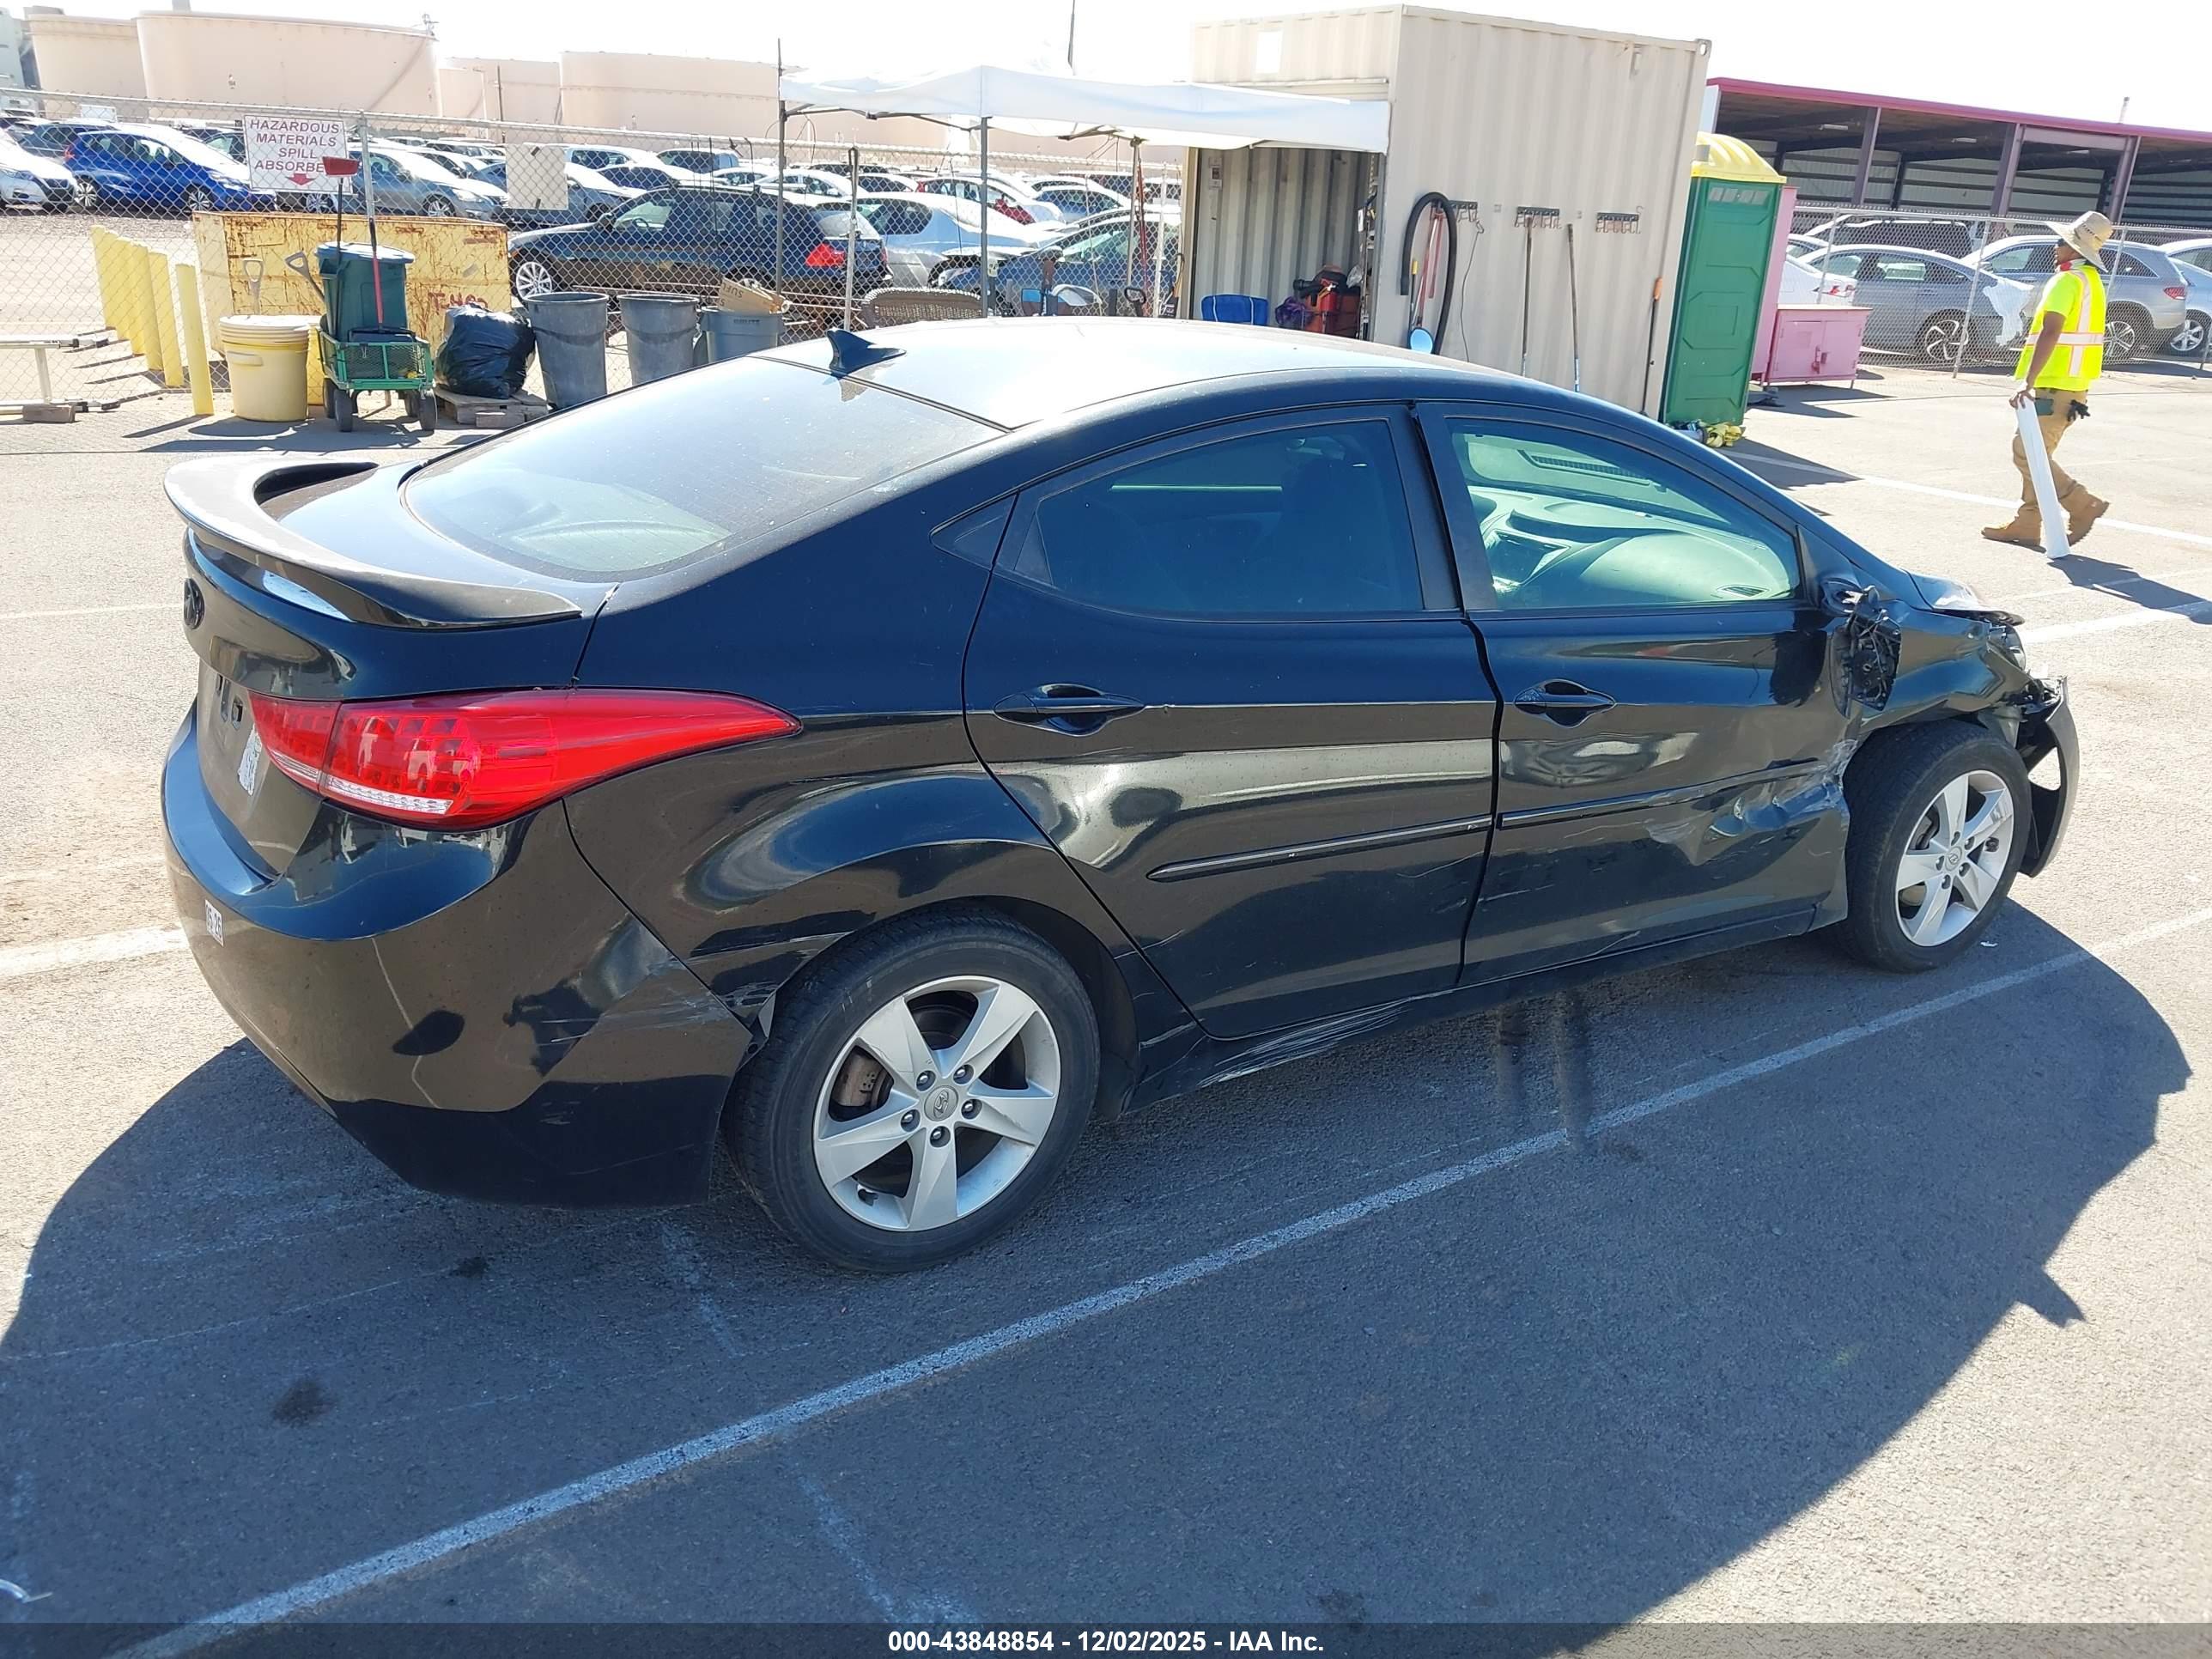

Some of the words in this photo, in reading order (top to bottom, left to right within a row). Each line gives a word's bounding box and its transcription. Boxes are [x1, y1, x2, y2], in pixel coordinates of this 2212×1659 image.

[250, 120, 339, 133] HAZARDOUS
[256, 133, 337, 147] MATERIALS
[277, 147, 317, 159] SPILL
[254, 161, 325, 173] ABSORBE
